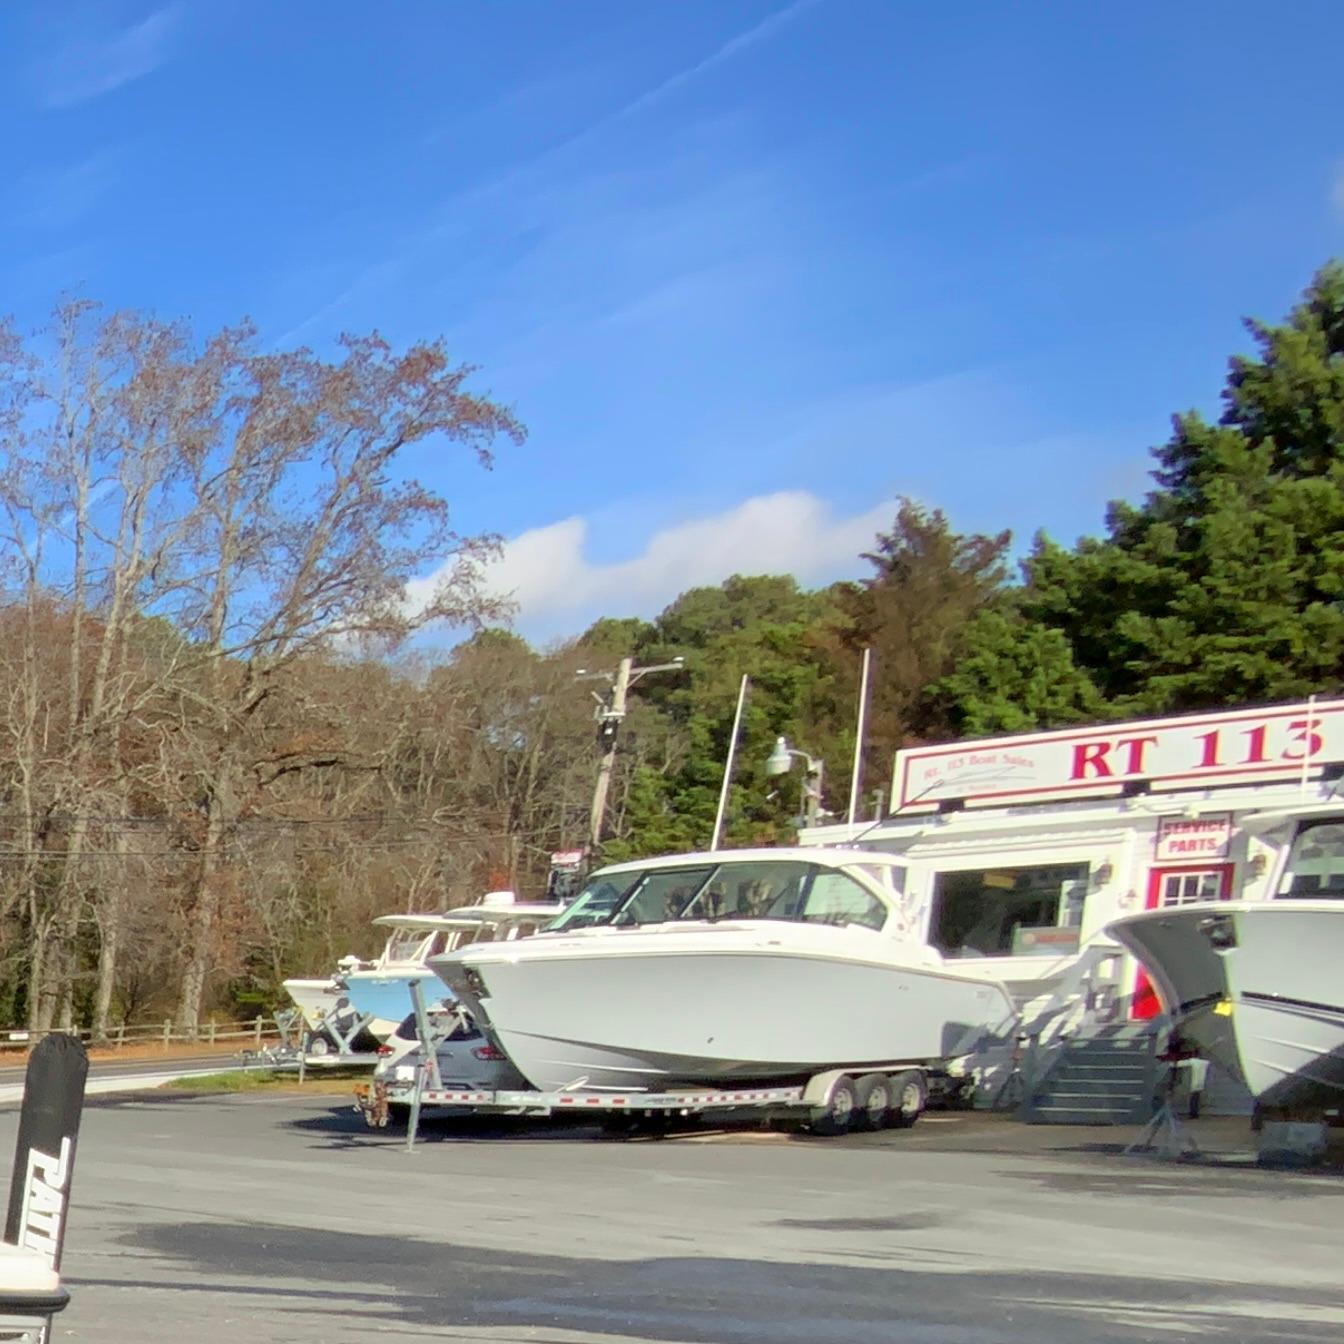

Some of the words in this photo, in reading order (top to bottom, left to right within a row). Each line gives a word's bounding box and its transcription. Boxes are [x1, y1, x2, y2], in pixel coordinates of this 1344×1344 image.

[1069, 735, 1159, 780] RT
[1191, 719, 1323, 769] 113
[968, 755, 997, 765] Boat
[1164, 819, 1226, 834] SERVICE
[1168, 838, 1217, 852] PARTS
